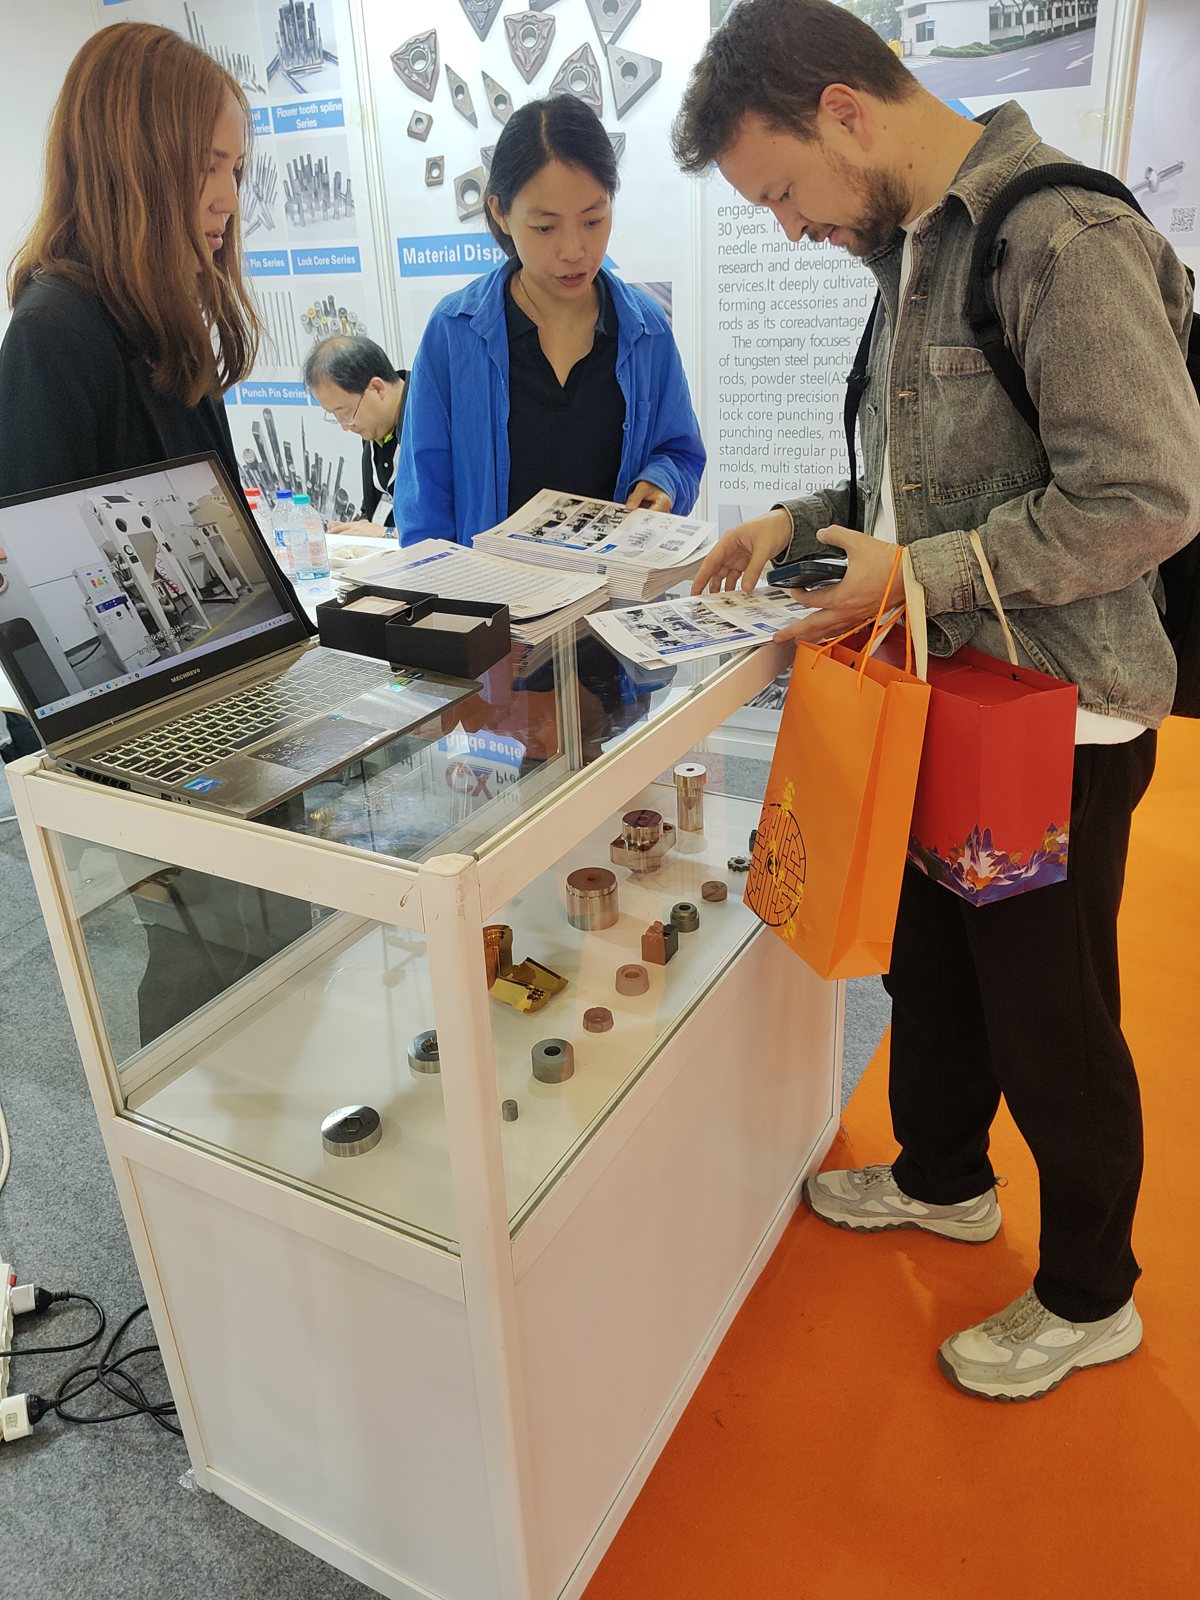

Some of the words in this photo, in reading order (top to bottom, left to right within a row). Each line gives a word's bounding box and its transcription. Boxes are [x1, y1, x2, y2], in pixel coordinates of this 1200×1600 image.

[300, 103, 319, 115] tooth
[320, 101, 343, 114] spline
[296, 118, 318, 129] Series
[717, 221, 733, 237] 30
[736, 222, 769, 239] years.
[773, 219, 782, 233] It
[402, 244, 460, 265] Material
[717, 239, 758, 256] needle
[761, 237, 849, 254] manuactur
[250, 258, 262, 269] Pin
[262, 257, 286, 268] Series
[297, 256, 313, 267] Lock
[313, 255, 330, 266] Core
[330, 253, 357, 265] Series
[718, 258, 764, 275] research
[767, 256, 790, 272] and
[779, 275, 820, 294] deeply
[823, 272, 879, 290] cultivate
[718, 297, 766, 315] forming
[770, 294, 839, 311] accessories
[842, 293, 868, 308] and
[718, 315, 744, 331] rods
[747, 319, 760, 330] as
[763, 314, 776, 330] its
[780, 312, 866, 332] coreadvantage
[731, 335, 752, 349] The
[756, 336, 807, 352] company
[810, 333, 851, 348] focuses
[718, 353, 731, 368] of
[734, 354, 781, 370] tungsten
[784, 352, 809, 367] steel
[718, 372, 747, 387] rods,
[751, 372, 797, 388] powder
[242, 387, 267, 398] Punch
[268, 387, 282, 398] Pin
[282, 388, 307, 399] Series
[718, 389, 783, 406] supporting
[786, 389, 840, 404] precision
[718, 408, 743, 421] lock
[747, 411, 773, 421] core
[776, 408, 834, 425] punching
[718, 426, 773, 442] punching
[776, 426, 825, 441] needles,
[718, 444, 770, 457] standard
[773, 444, 826, 460] irregular
[830, 446, 863, 461] puc
[718, 461, 757, 475] molds,
[760, 462, 790, 475] multi
[793, 462, 834, 475] station
[838, 462, 863, 475] bot
[718, 478, 750, 492] rods,
[752, 478, 801, 492] medical
